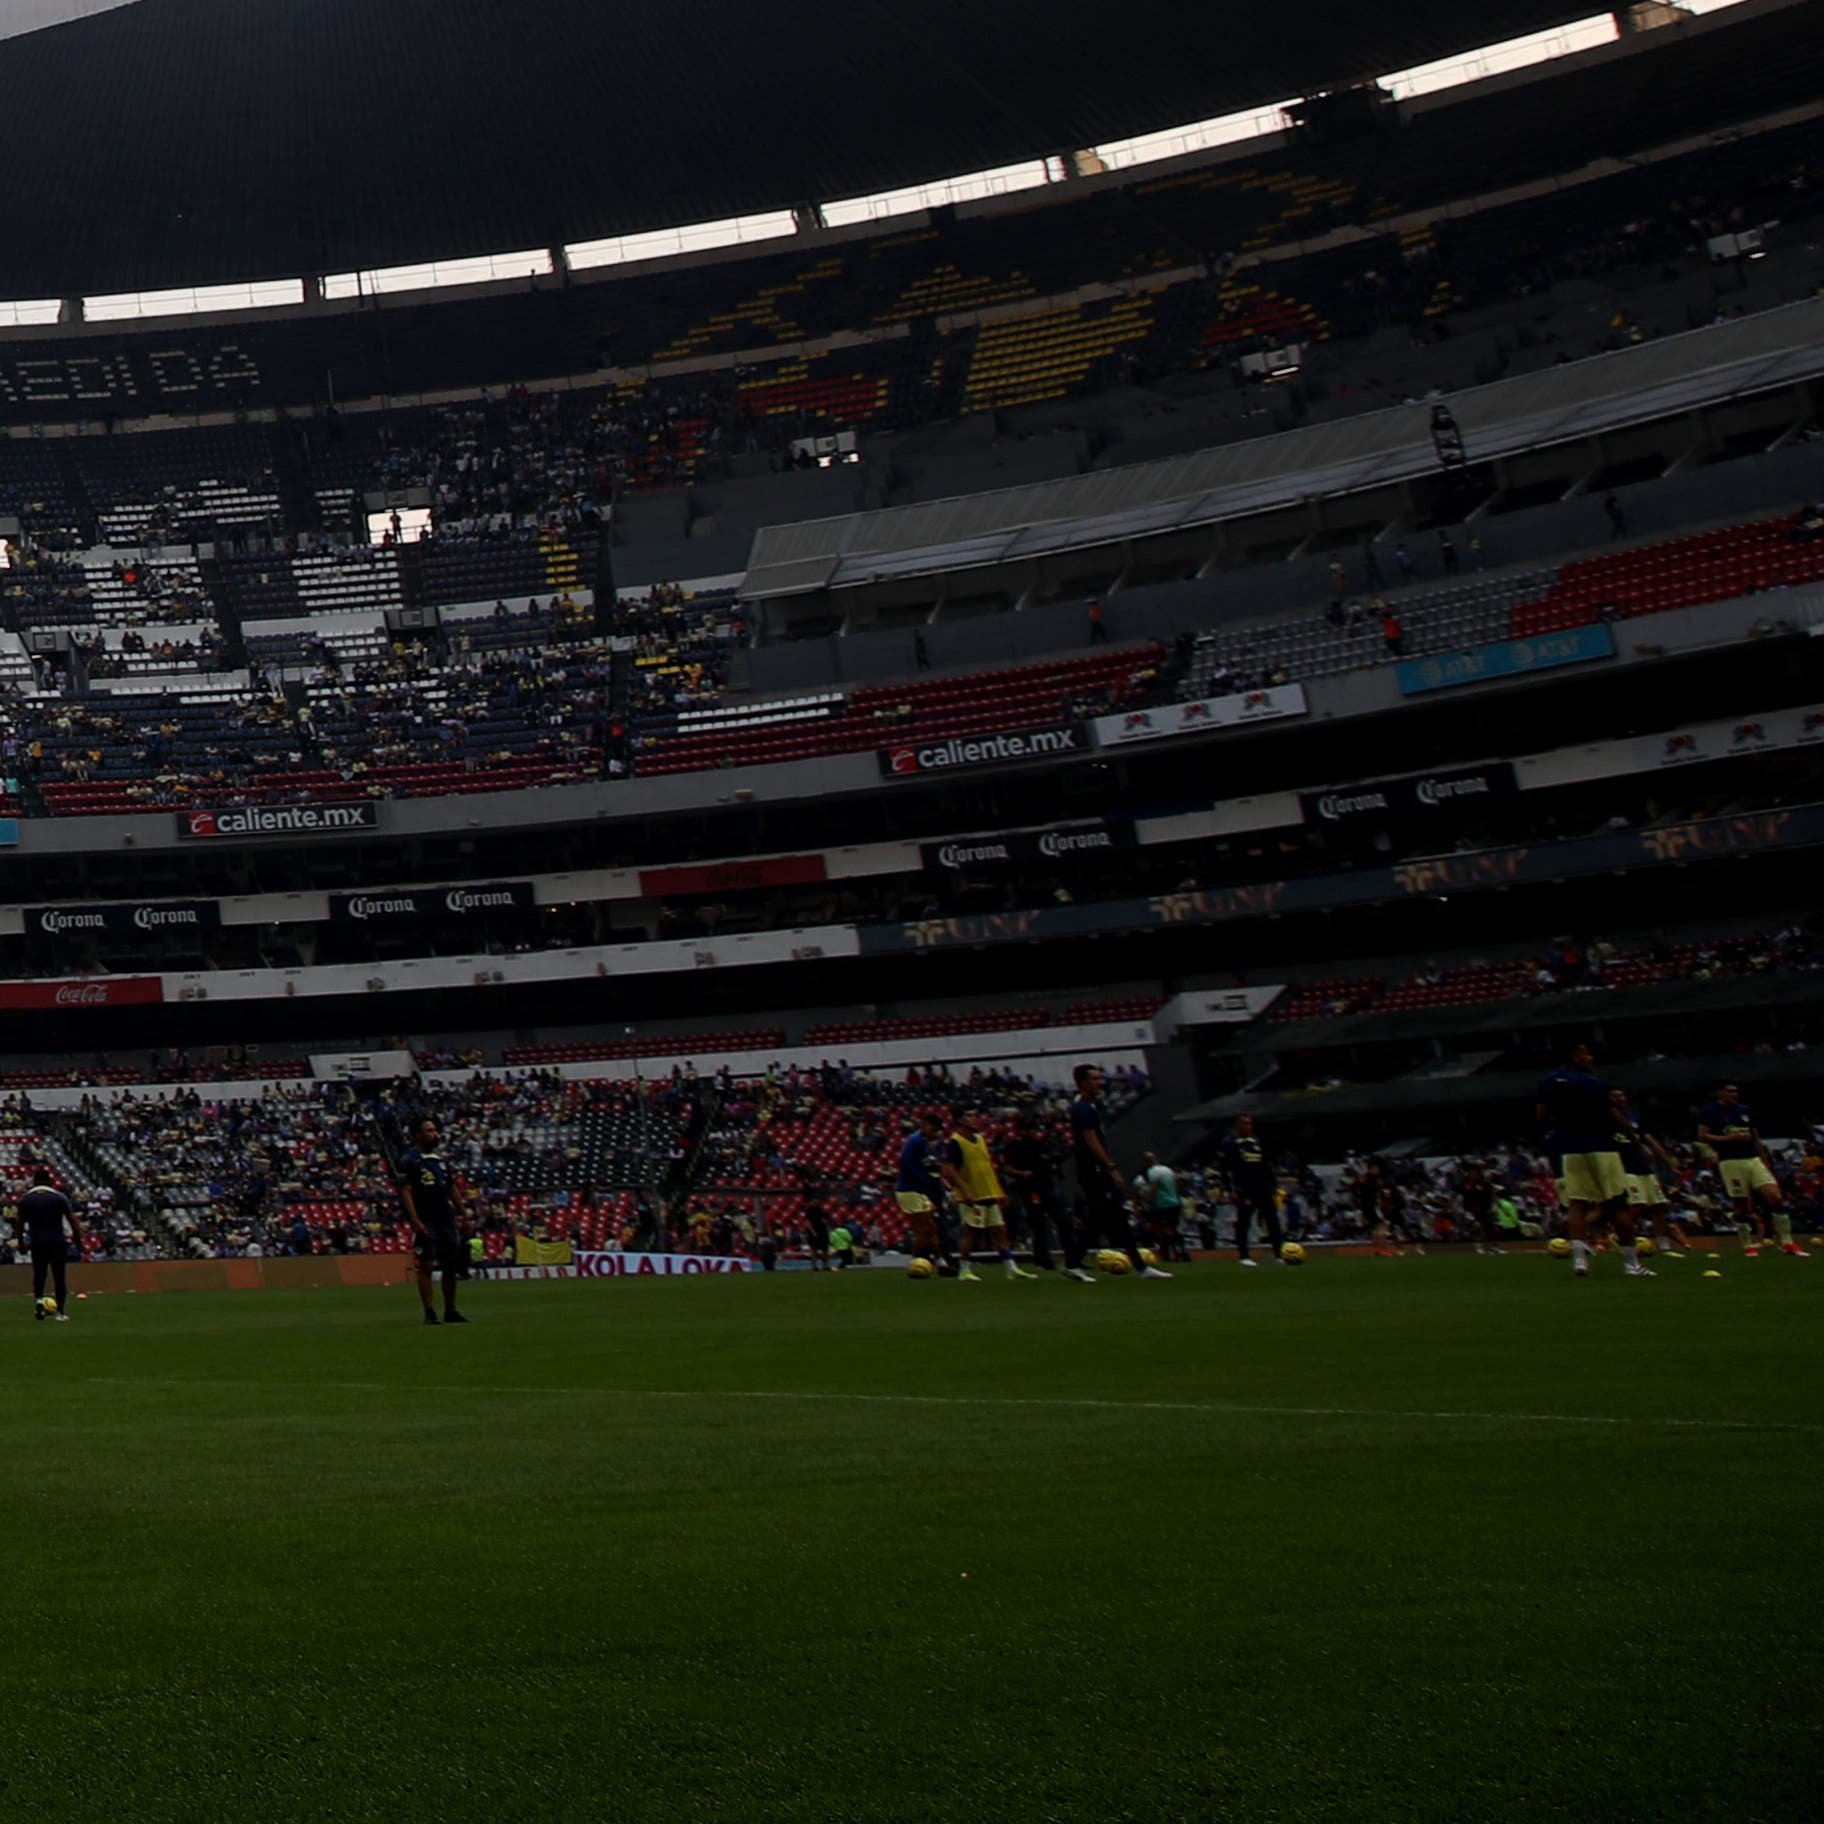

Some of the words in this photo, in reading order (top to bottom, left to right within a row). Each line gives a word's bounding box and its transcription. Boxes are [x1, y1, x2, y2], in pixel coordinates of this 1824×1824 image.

[919, 728, 1076, 767] caliente.mx
[1318, 789, 1387, 819] Corona
[1416, 776, 1488, 805] Corona
[217, 805, 365, 833] caliente.mx
[939, 843, 1007, 868] Corona
[1039, 830, 1110, 857] Corona
[348, 897, 416, 920] Corona
[446, 890, 513, 913] Corona
[41, 911, 105, 934] Corona
[134, 907, 197, 930] Corona
[577, 1254, 655, 1277] KOLA
[663, 1256, 744, 1275] LOKA
